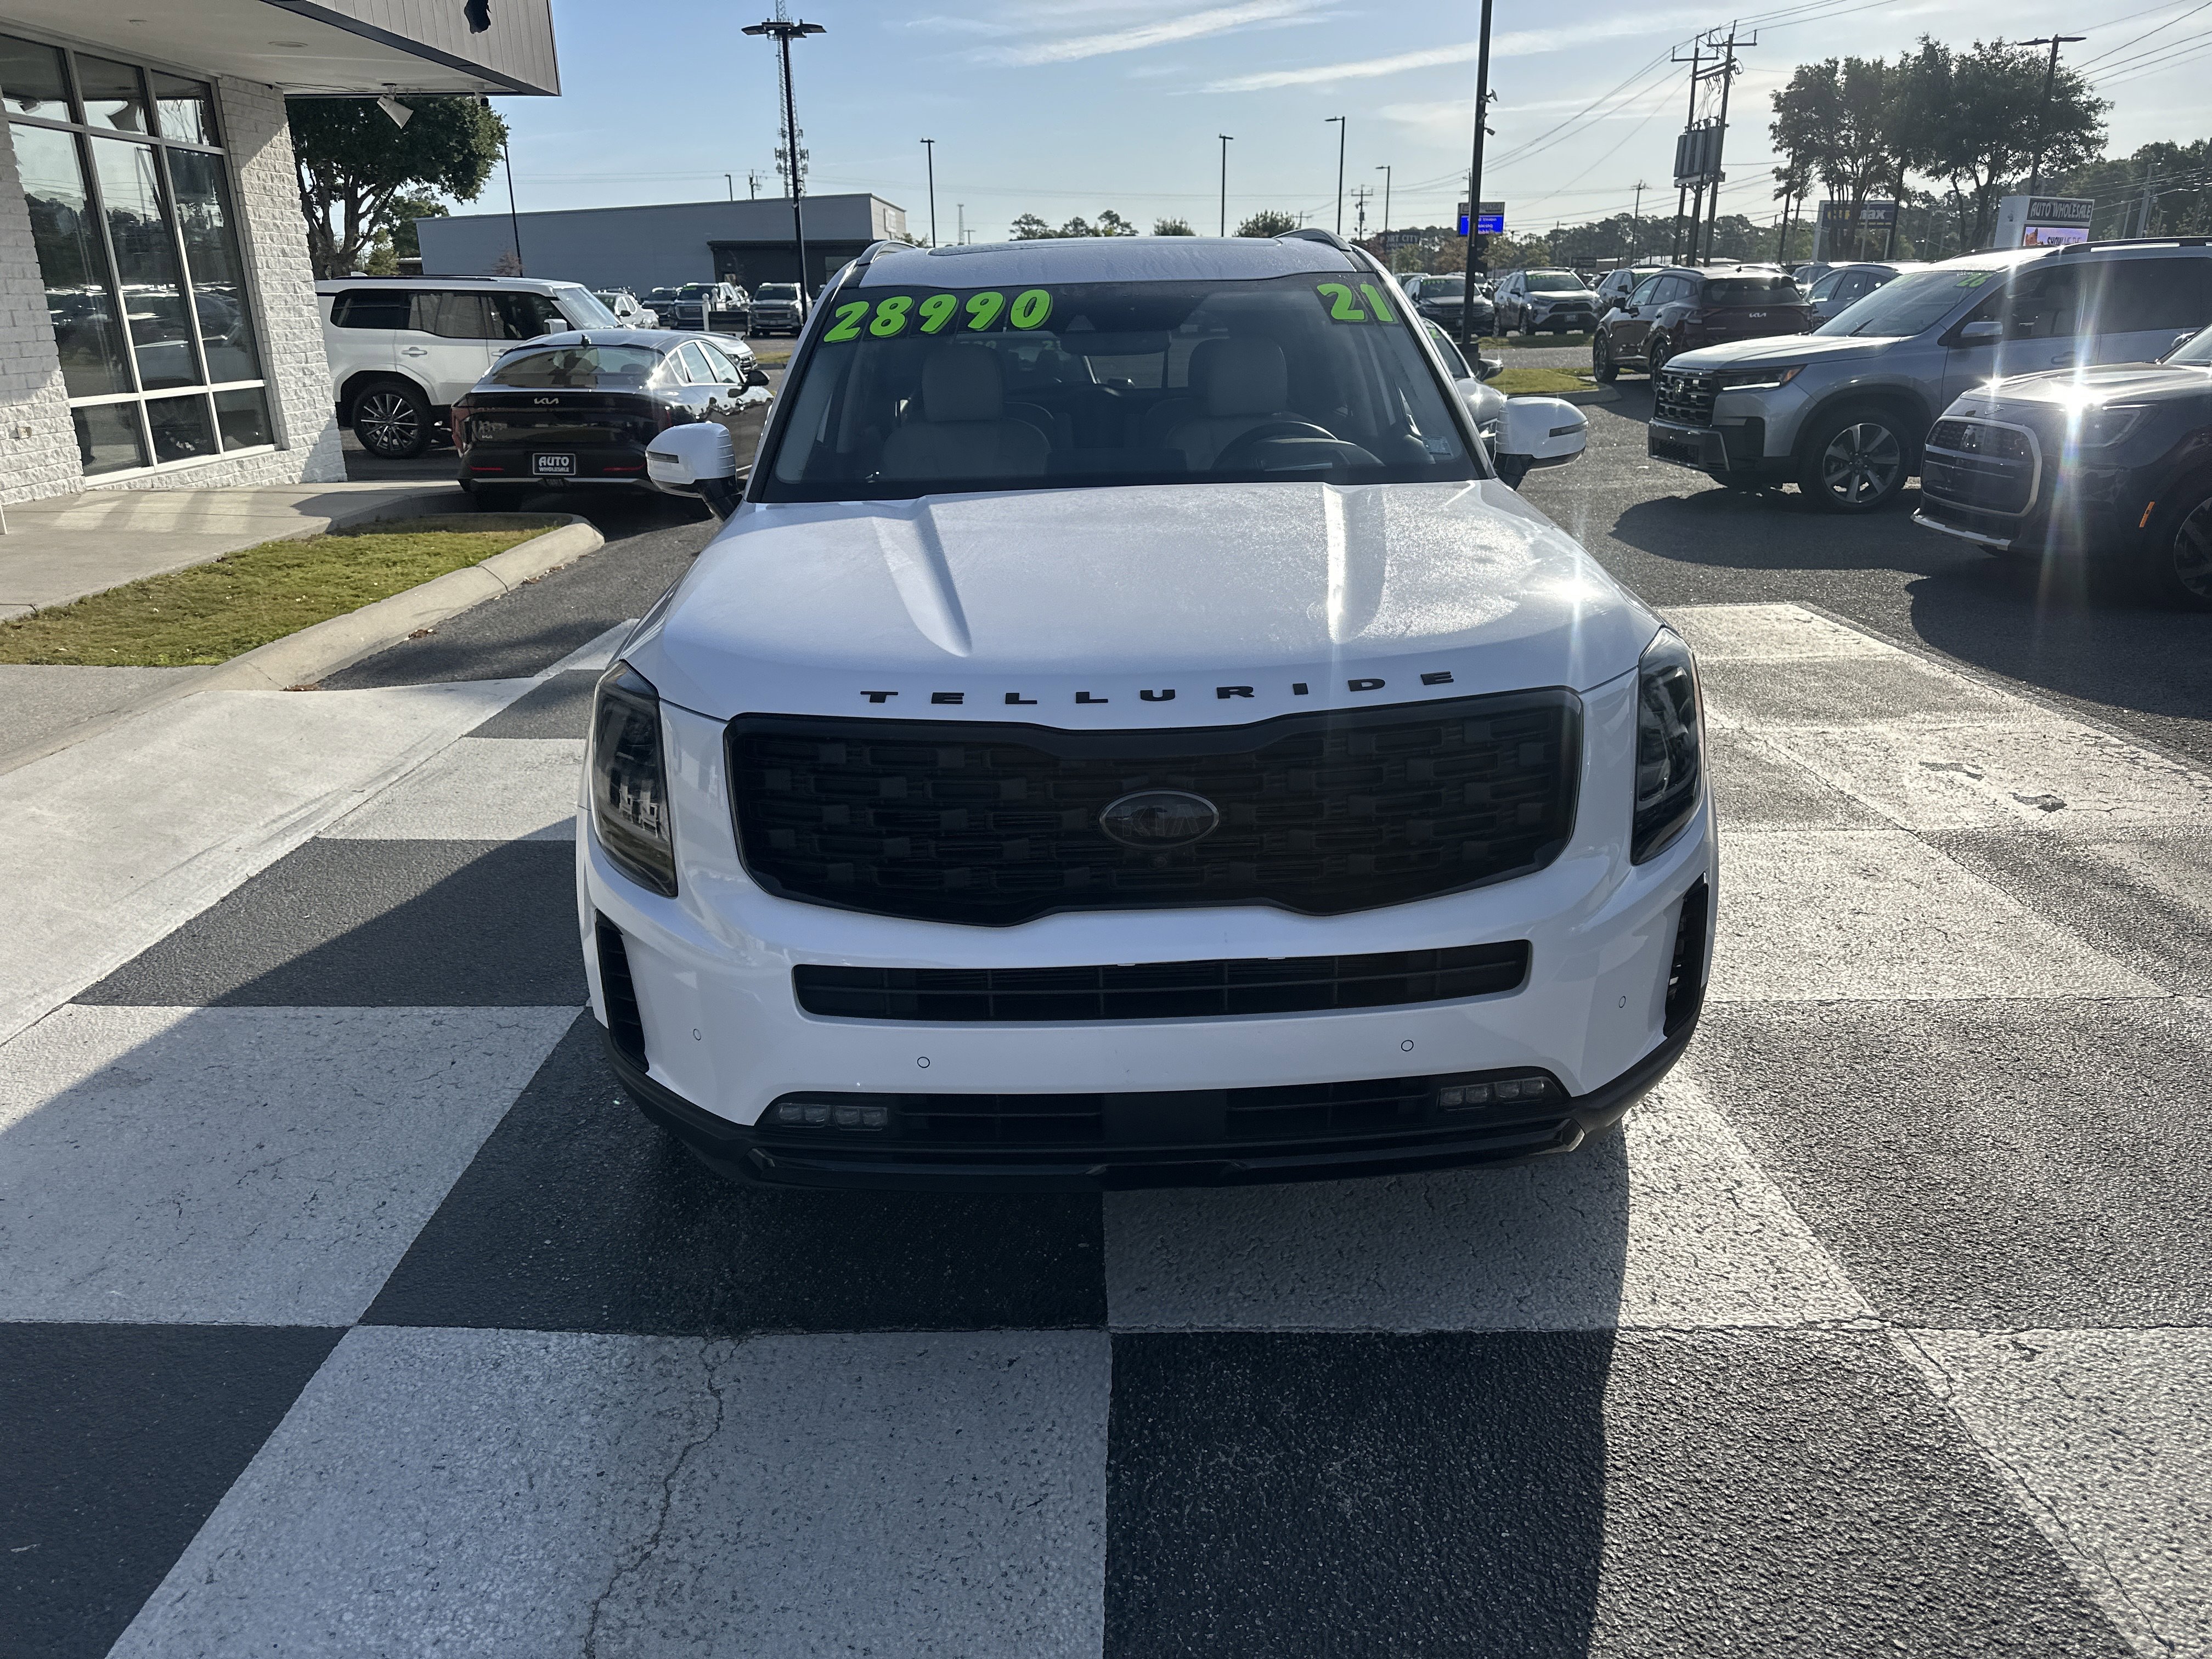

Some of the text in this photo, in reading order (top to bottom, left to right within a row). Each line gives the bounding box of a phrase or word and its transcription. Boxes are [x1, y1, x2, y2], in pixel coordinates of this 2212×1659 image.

[2030, 201, 2092, 219] AUTO WHOLESALE
[1401, 234, 1419, 243] CITY
[1956, 274, 1993, 289] 26
[824, 290, 1053, 342] 28990
[1317, 283, 1398, 324] 21
[539, 456, 569, 466] AUTO
[860, 671, 1454, 705] TELLURIDE
[1120, 804, 1200, 837] KIA
